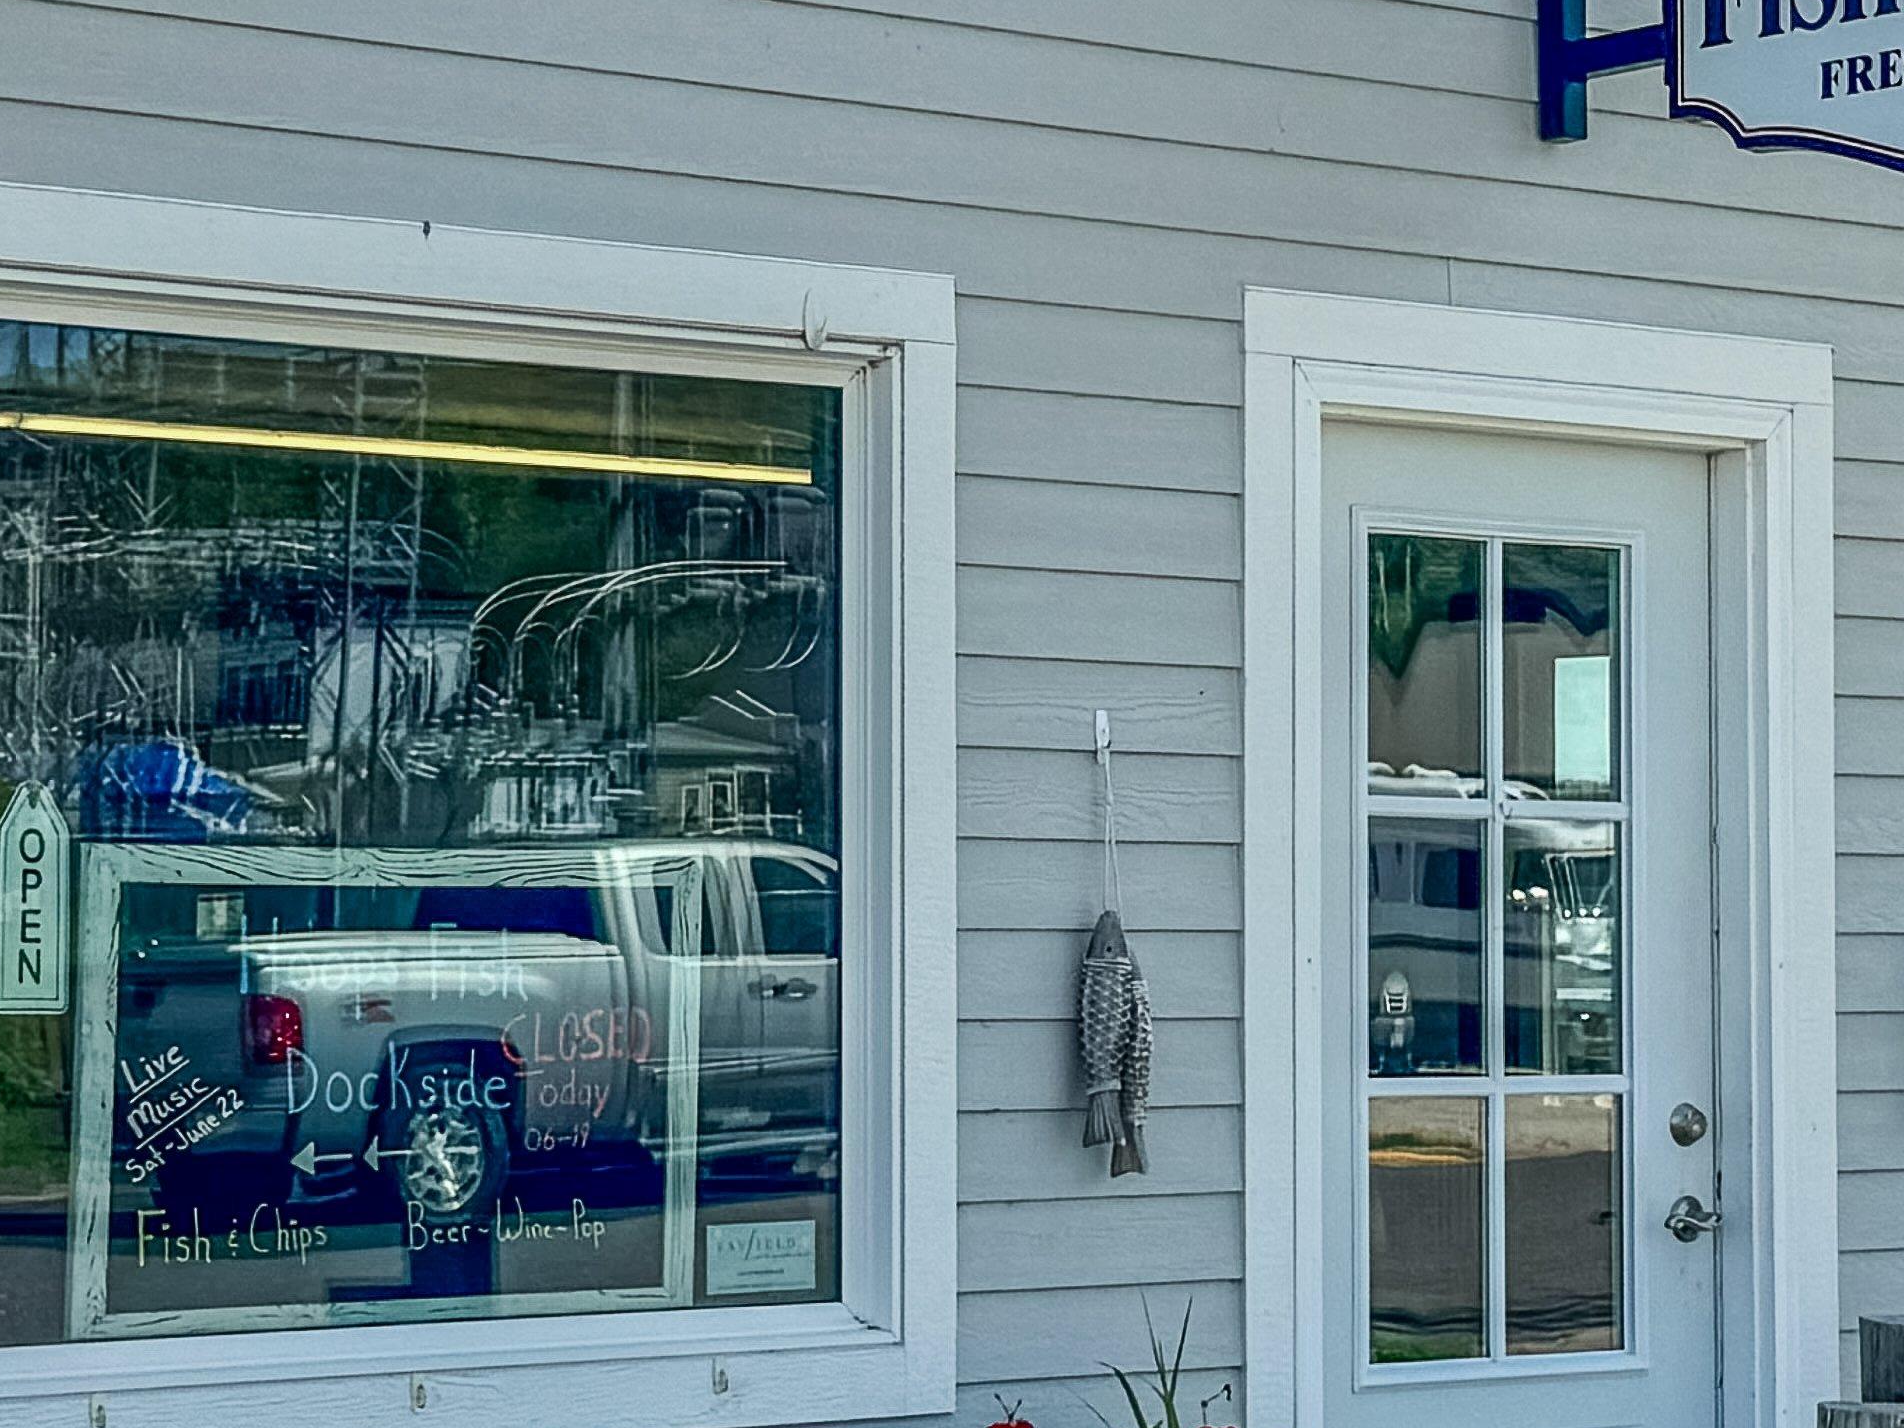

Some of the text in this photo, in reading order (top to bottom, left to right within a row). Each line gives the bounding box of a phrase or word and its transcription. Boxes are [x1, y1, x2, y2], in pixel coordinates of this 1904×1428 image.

[17, 827, 45, 985] OPEN
[121, 1045, 186, 1094] Live
[126, 1077, 210, 1139] Music
[216, 1088, 245, 1118] 22
[137, 1206, 212, 1268] Fish
[250, 1203, 328, 1266] Chips
